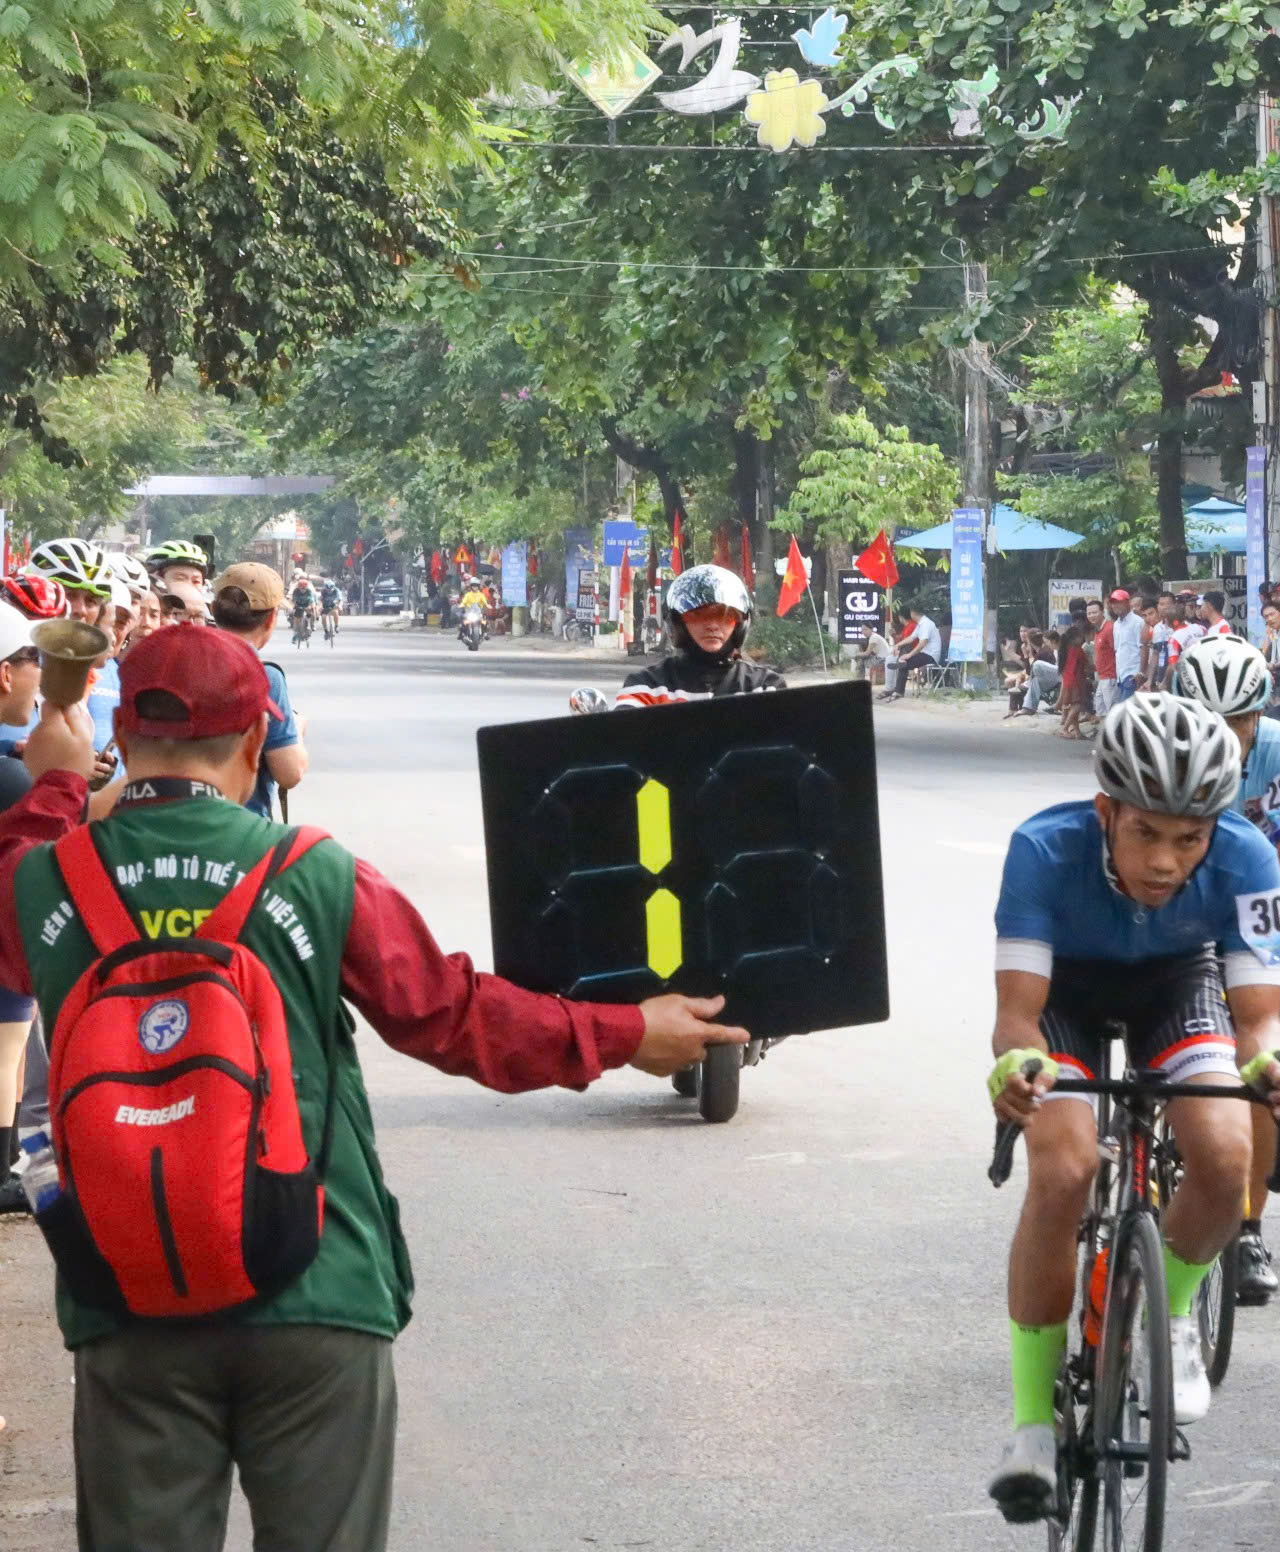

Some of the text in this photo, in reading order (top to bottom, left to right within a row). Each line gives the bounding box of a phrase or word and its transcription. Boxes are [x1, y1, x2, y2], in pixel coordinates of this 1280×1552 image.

[191, 781, 226, 801] FIL
[40, 911, 67, 946] LIÊN
[154, 854, 177, 879] MÔ
[182, 855, 199, 880] TÔ
[289, 923, 314, 960] NAM
[115, 1095, 195, 1126] EVEREADY
